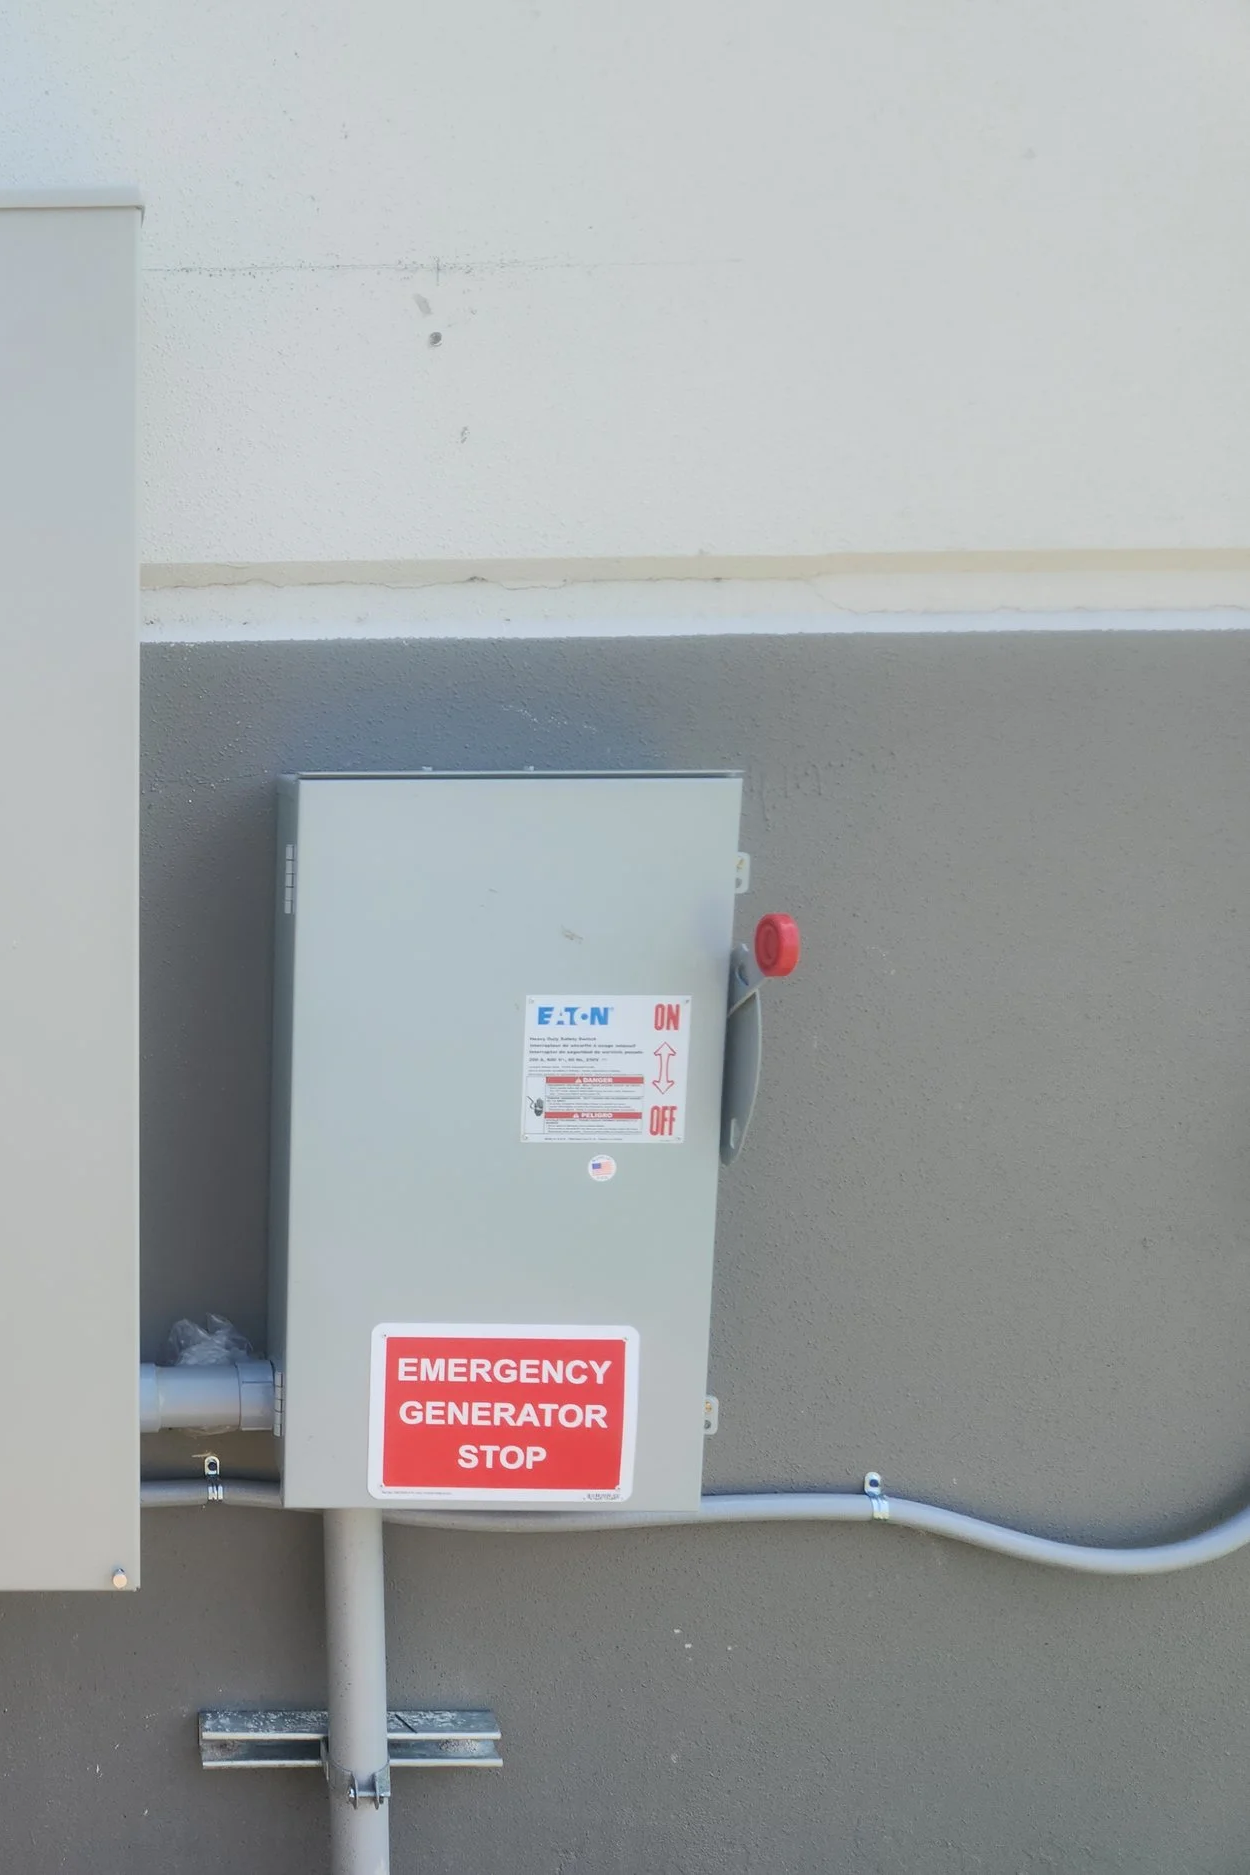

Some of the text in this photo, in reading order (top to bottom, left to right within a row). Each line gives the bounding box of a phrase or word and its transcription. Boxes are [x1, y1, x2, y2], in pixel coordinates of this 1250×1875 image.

[654, 1003, 680, 1031] ON
[649, 1105, 678, 1136] OFF
[397, 1357, 612, 1385] EMERGENCY
[398, 1400, 608, 1429] GENERATOR
[457, 1444, 547, 1470] STOP
